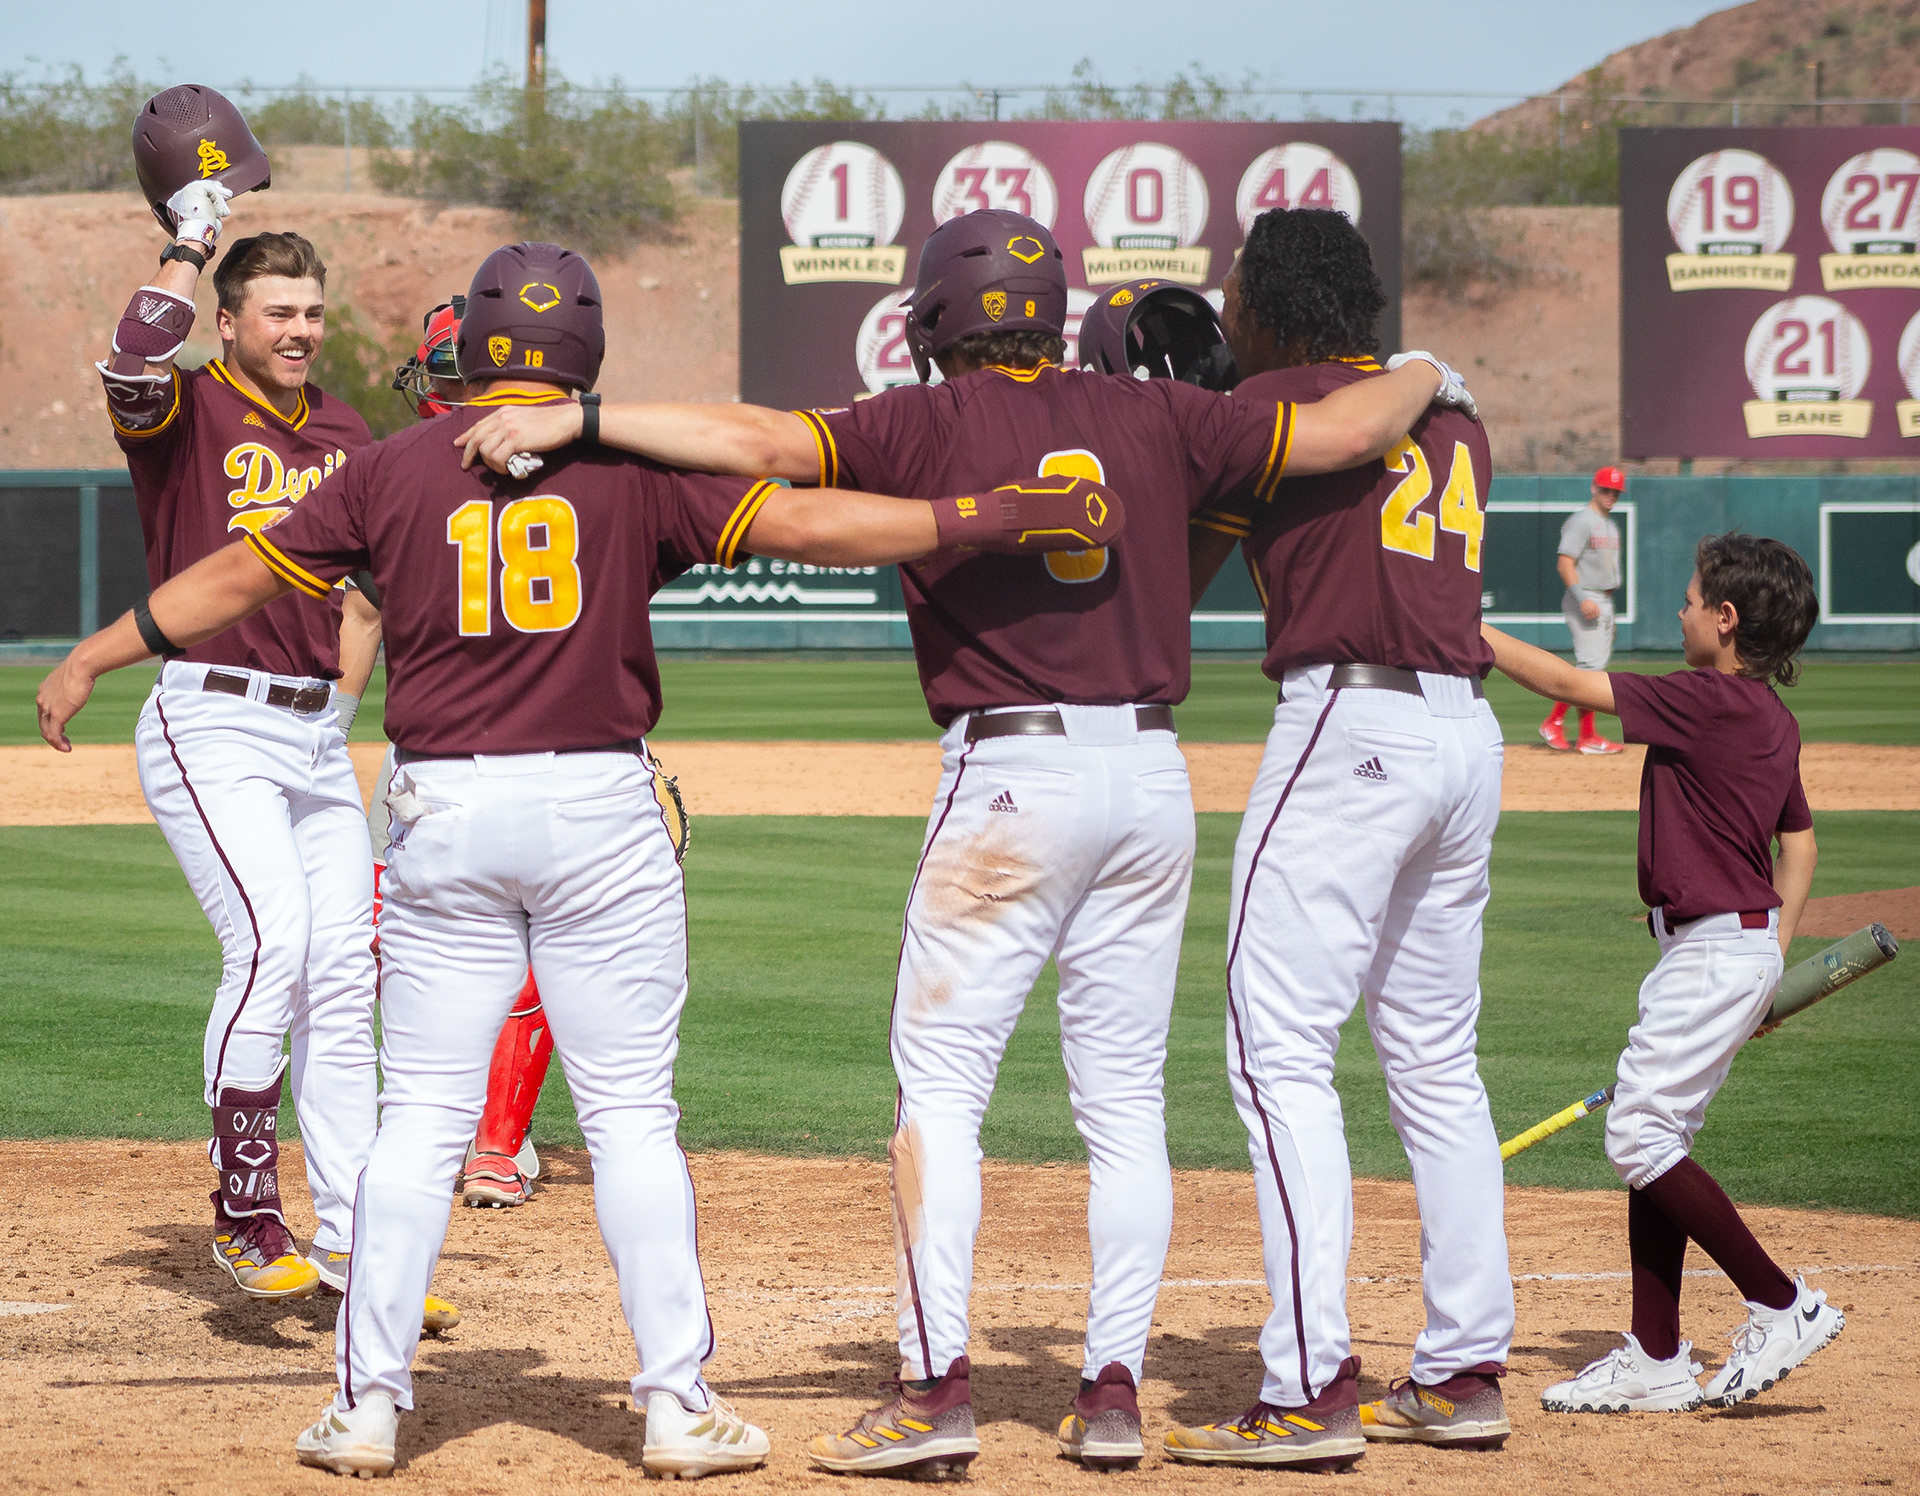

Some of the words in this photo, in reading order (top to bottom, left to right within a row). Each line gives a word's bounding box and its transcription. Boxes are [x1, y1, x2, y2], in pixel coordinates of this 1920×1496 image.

[829, 162, 849, 219] 1
[955, 168, 1031, 216] 33
[1255, 168, 1334, 210] 44
[1698, 175, 1759, 232] 19
[1845, 174, 1920, 231] 27
[793, 258, 895, 273] WINKLES
[1088, 259, 1201, 274] McDOWELL
[1673, 264, 1787, 280] BANNISTER
[989, 304, 1001, 316] 12
[1024, 300, 1036, 317] 9
[1773, 320, 1834, 376] 21
[524, 349, 544, 368] 18
[1776, 411, 1842, 425] BANE
[956, 497, 978, 519] 18
[1381, 434, 1485, 573] 24
[447, 494, 583, 637] 18
[1352, 767, 1388, 781] adidas
[988, 803, 1019, 814] adidas
[264, 1115, 276, 1131] 21
